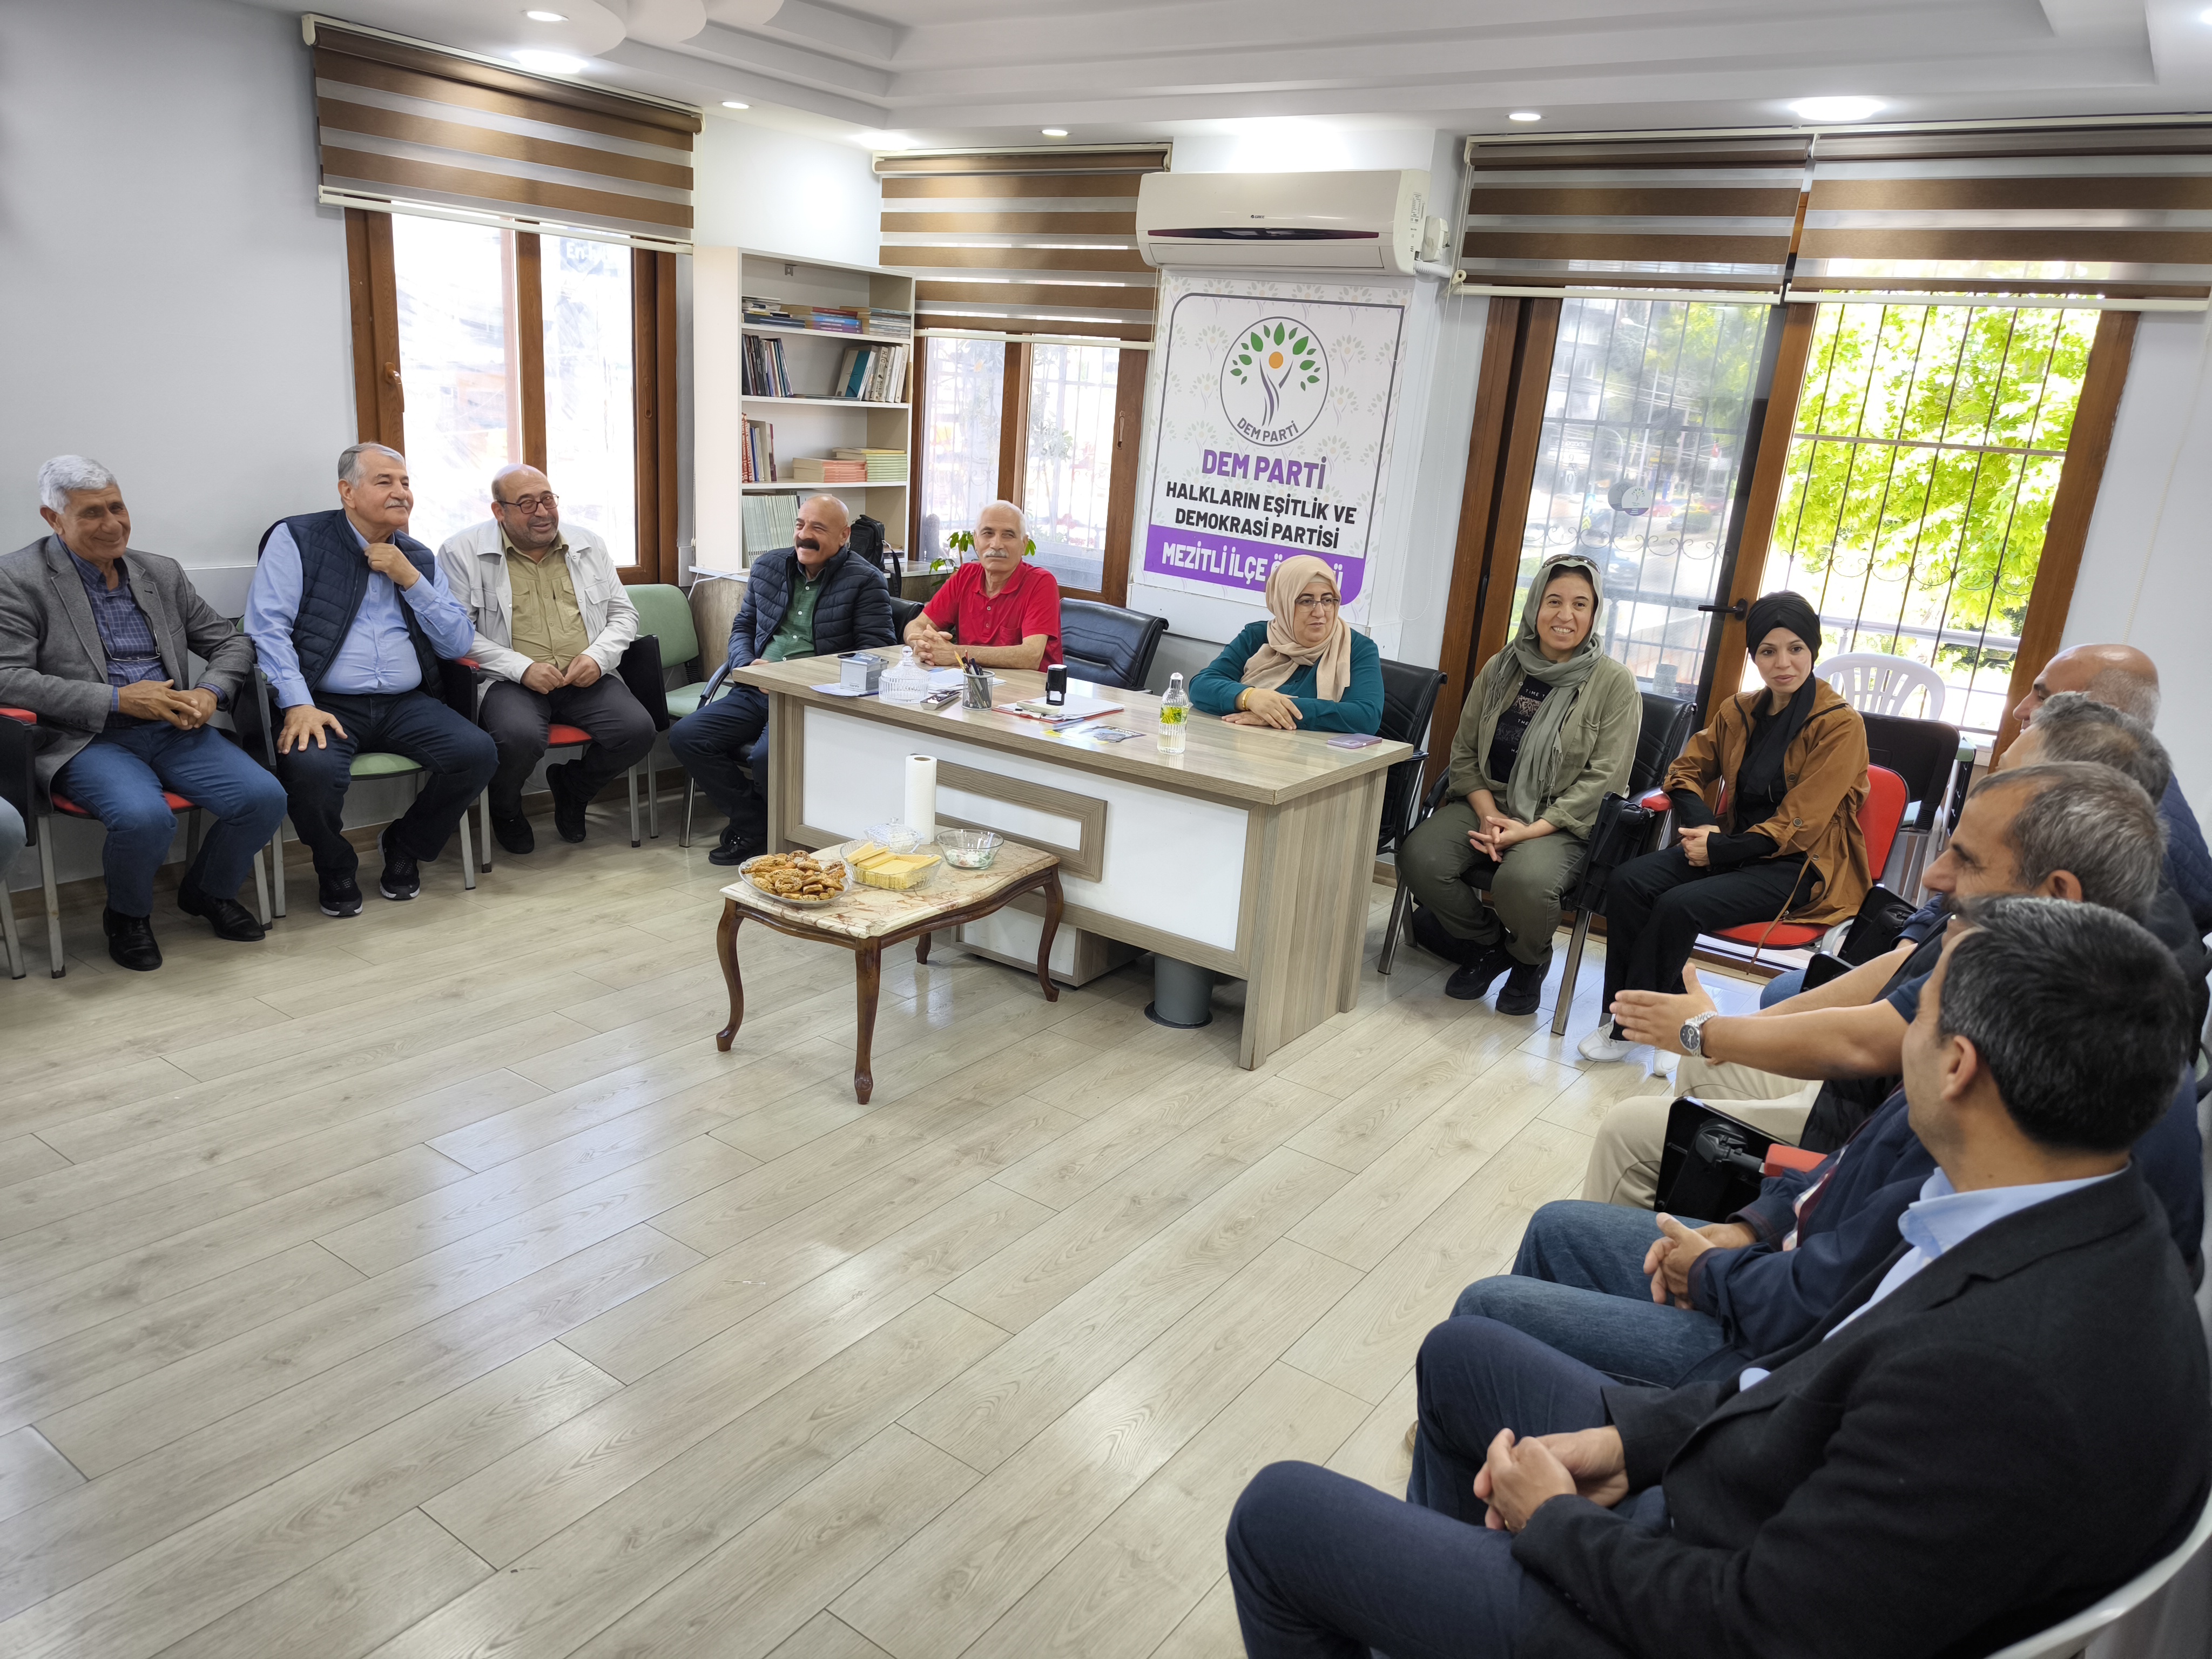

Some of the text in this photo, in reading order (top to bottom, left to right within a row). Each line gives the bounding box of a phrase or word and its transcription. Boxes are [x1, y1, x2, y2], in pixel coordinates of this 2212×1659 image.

[1237, 417, 1299, 442] DEM PARTİ
[1202, 449, 1326, 490] DEM PARTİ
[1166, 481, 1357, 524] HALKLARIN EŞİTLİK VE
[1175, 508, 1340, 549] DEMOKRASİ PARTİSİ
[1162, 541, 1228, 575] MEZİTLİ
[1228, 546, 1269, 585] İLÇE
[1525, 689, 1540, 697] TIME
